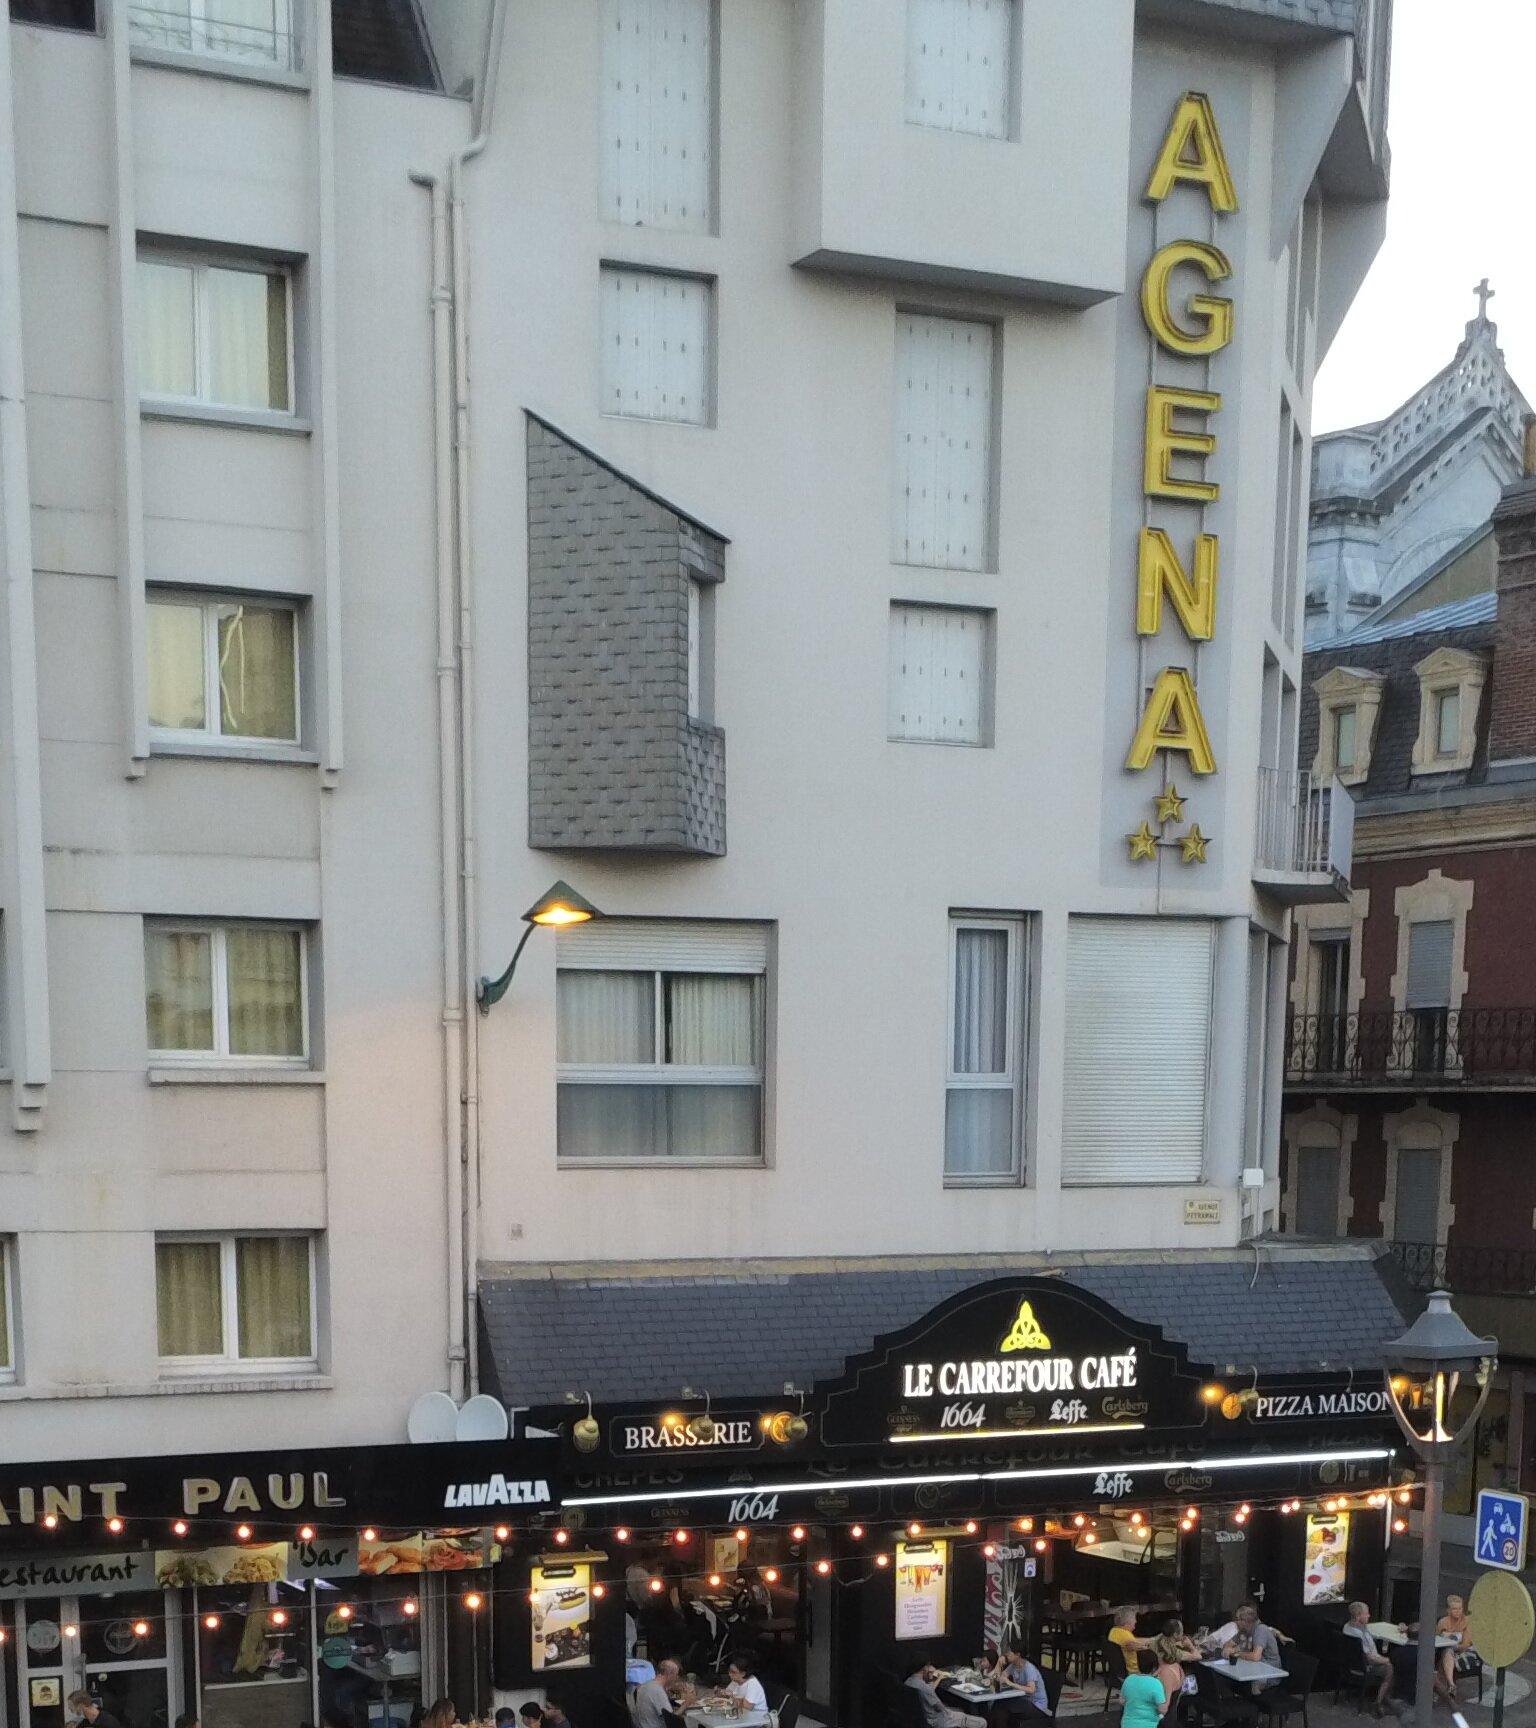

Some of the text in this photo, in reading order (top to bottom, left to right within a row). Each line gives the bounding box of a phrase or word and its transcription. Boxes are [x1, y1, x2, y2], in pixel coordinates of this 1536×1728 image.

[1125, 90, 1239, 774] AGENA
[904, 1346, 1137, 1397] LE CARREFOUR CAFÉ
[940, 1401, 986, 1428] 1664
[1048, 1398, 1088, 1423] Leffe
[1101, 1396, 1149, 1420] Carlsberg
[1255, 1396, 1313, 1418] PIZZA
[183, 1472, 346, 1516] PAUL
[445, 1474, 551, 1508] LAVAZZA
[728, 1493, 779, 1522] 1664
[1093, 1472, 1134, 1498] Leffe
[1164, 1471, 1213, 1492] Carlsberg
[293, 1540, 349, 1567] Bar
